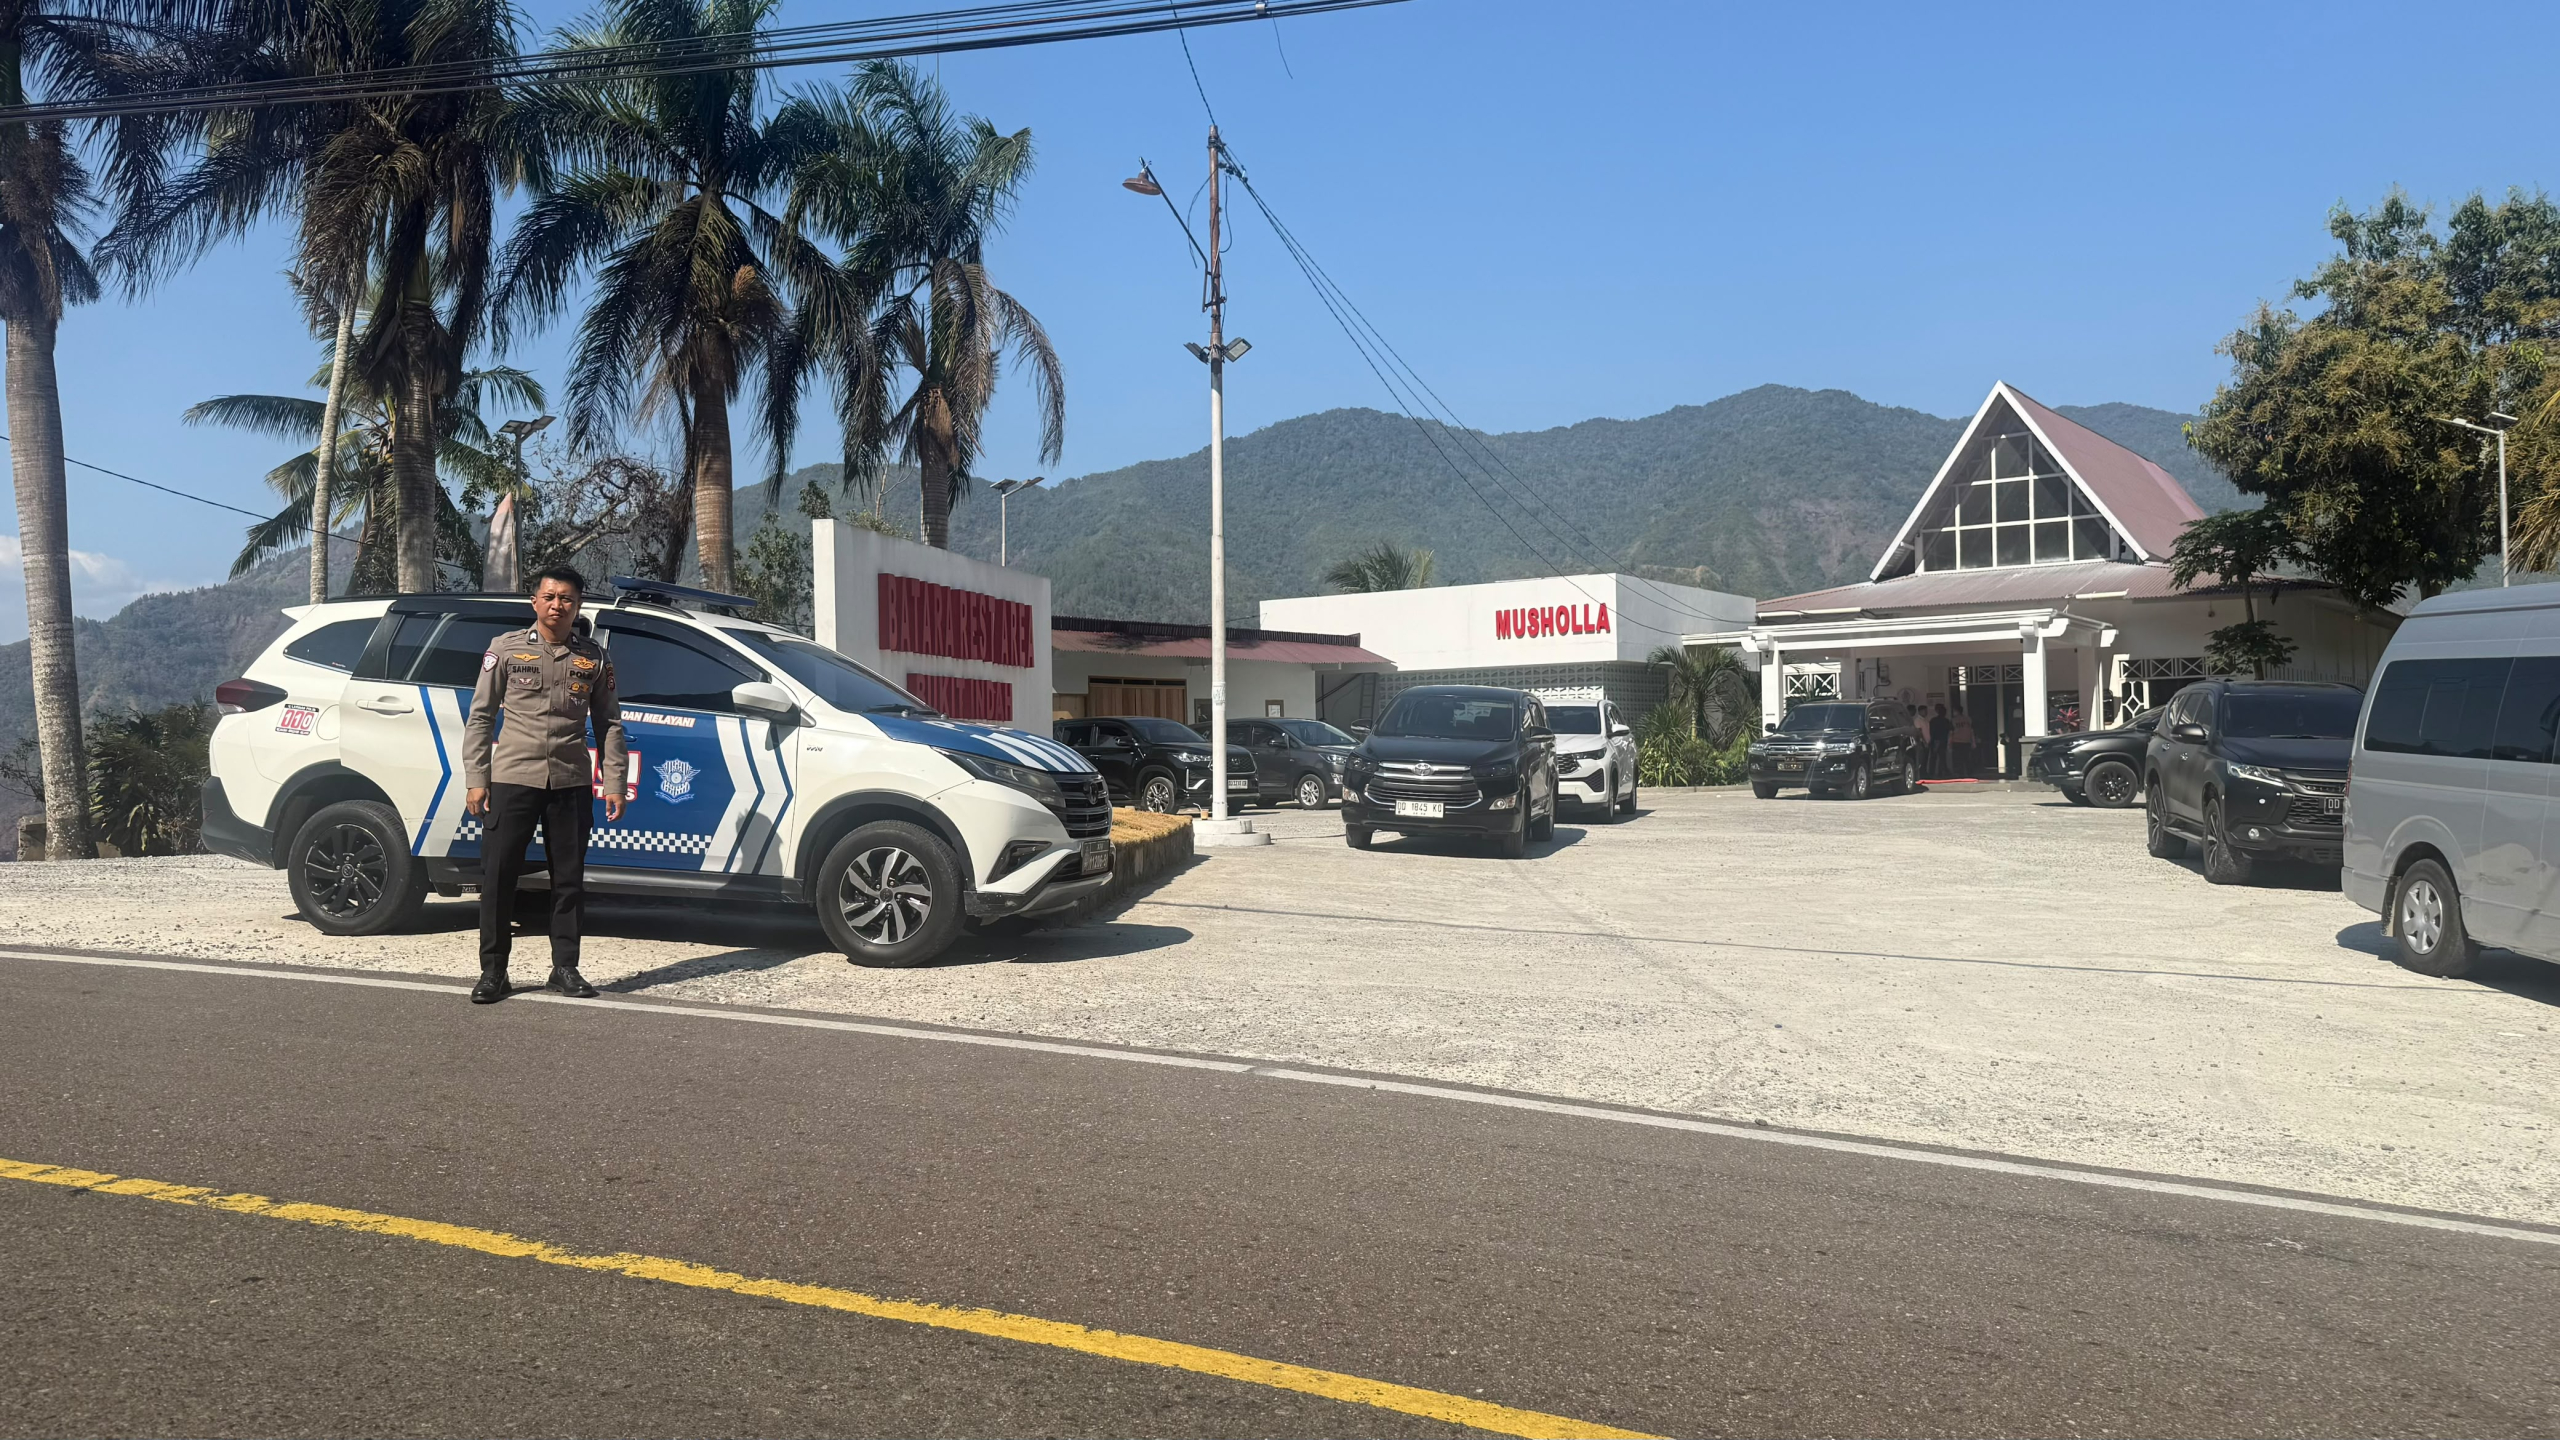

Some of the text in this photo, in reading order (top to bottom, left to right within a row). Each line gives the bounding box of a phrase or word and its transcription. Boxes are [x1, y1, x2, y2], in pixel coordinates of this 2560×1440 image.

[880, 573, 1035, 669] BATARA REST AREA
[1496, 602, 1611, 640] MUSHOLLA
[512, 665, 541, 674] SAHRUL
[913, 673, 1013, 722] BUKIT INDAH
[282, 710, 314, 729] 110
[621, 710, 696, 728] DAN MELAYANI
